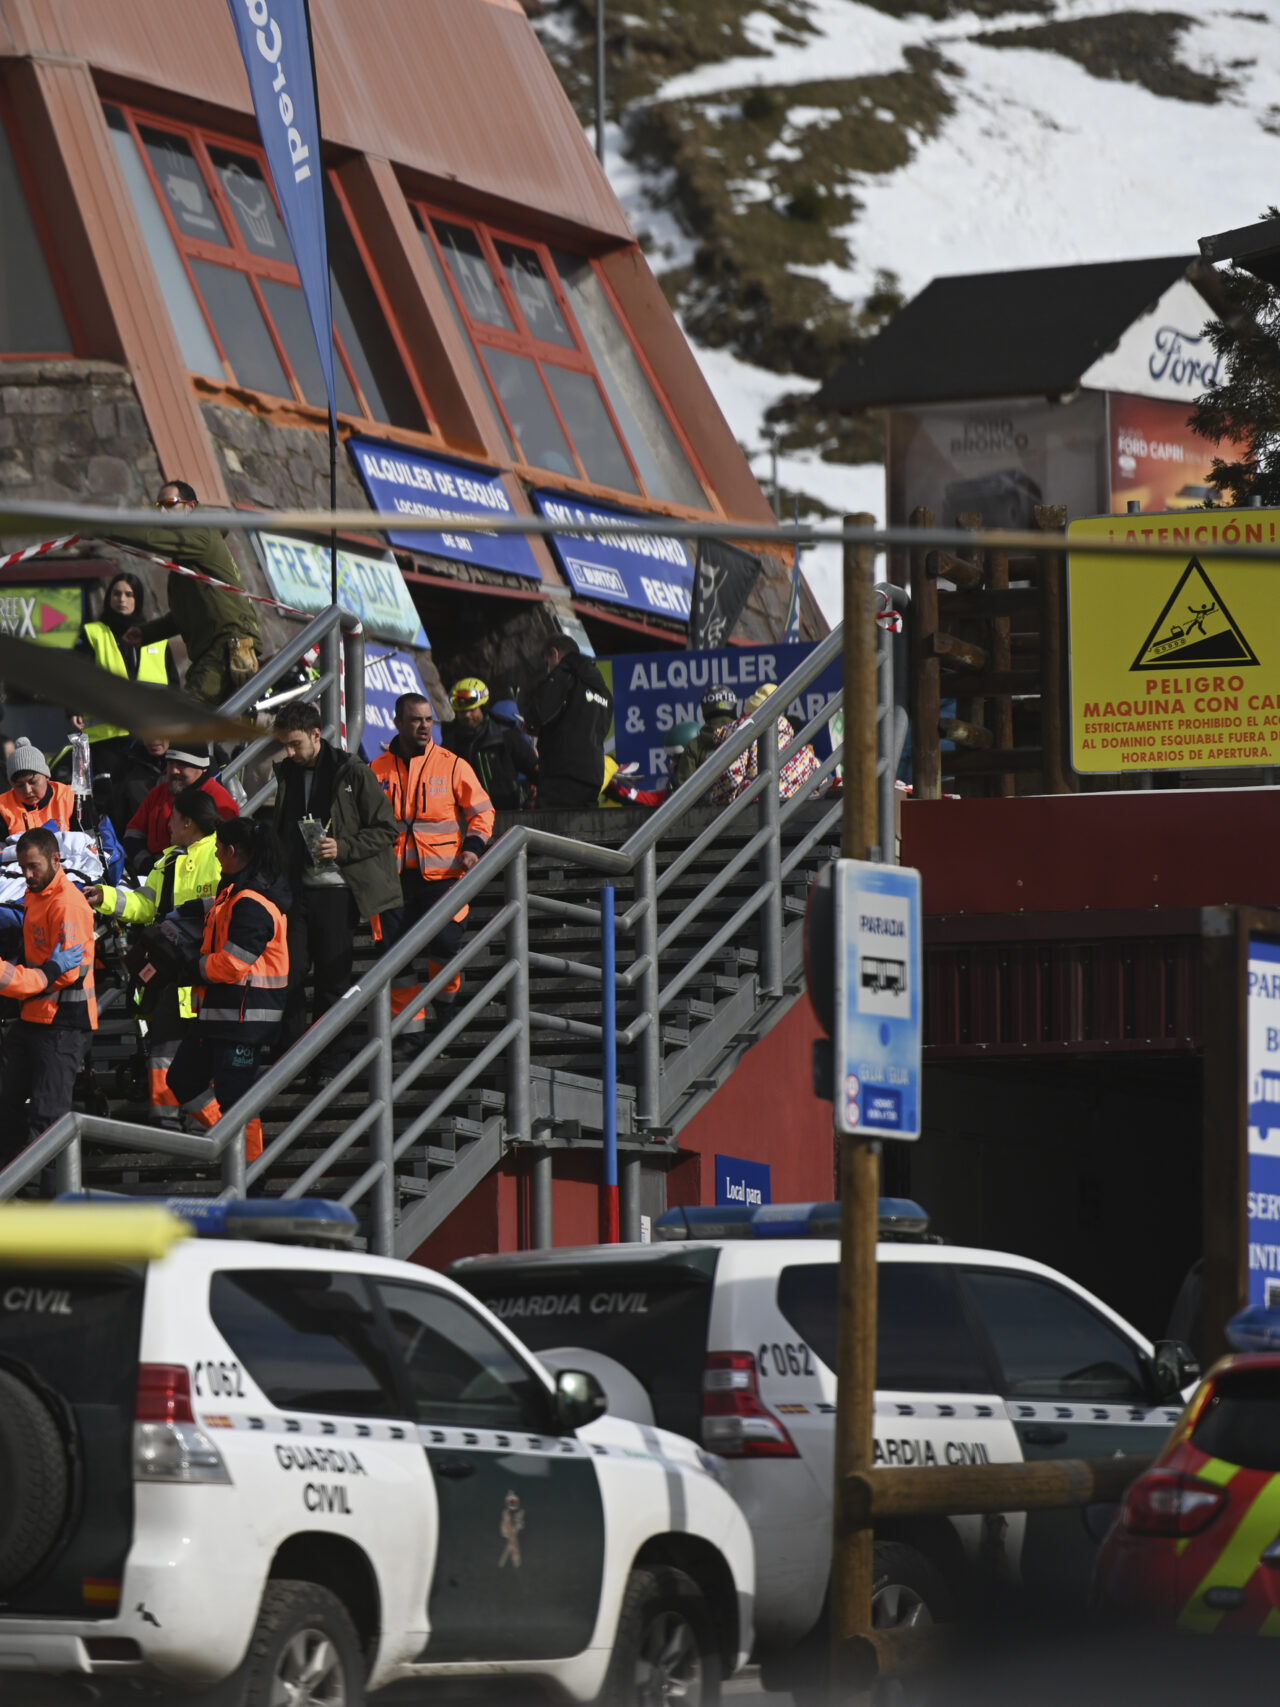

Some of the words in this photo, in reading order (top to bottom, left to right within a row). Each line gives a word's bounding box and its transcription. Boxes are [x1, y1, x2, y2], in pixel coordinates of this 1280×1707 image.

[1149, 326, 1221, 388] Ford
[1118, 436, 1148, 457] FORD
[1149, 441, 1184, 464] CAPRI
[363, 454, 438, 493] ALQUILER
[434, 472, 459, 498] DE
[394, 498, 441, 521] LOCATION
[441, 532, 459, 549] DE
[629, 653, 778, 691] ALQUILER
[1145, 674, 1245, 696] PELIGRO
[625, 705, 646, 734] &
[1083, 698, 1186, 718] MAQUINA
[1193, 696, 1239, 713] CON
[1084, 720, 1174, 735] ESTRICTAMENTE
[1177, 716, 1243, 731] PROHIBIDO
[1247, 715, 1260, 728] EL
[1263, 714, 1280, 727] AC
[1081, 740, 1097, 751] AL
[1100, 735, 1157, 750] DOMINIO
[1160, 732, 1225, 747] ESQUIABLE
[1228, 730, 1266, 743] FUERA
[1120, 750, 1185, 764] HORARIOS
[1188, 748, 1204, 761] DE
[1208, 746, 1273, 760] APERTURA.
[196, 884, 213, 894] 061
[859, 913, 907, 938] PARADA
[726, 1176, 745, 1201] Local
[746, 1183, 762, 1206] para
[3, 1288, 73, 1315] CIVIL
[589, 1292, 649, 1314] CIVIL
[773, 1343, 815, 1376] 062
[206, 1361, 245, 1397] 062
[274, 1444, 368, 1477] GUARDIA
[303, 1482, 352, 1514] CIVIL
